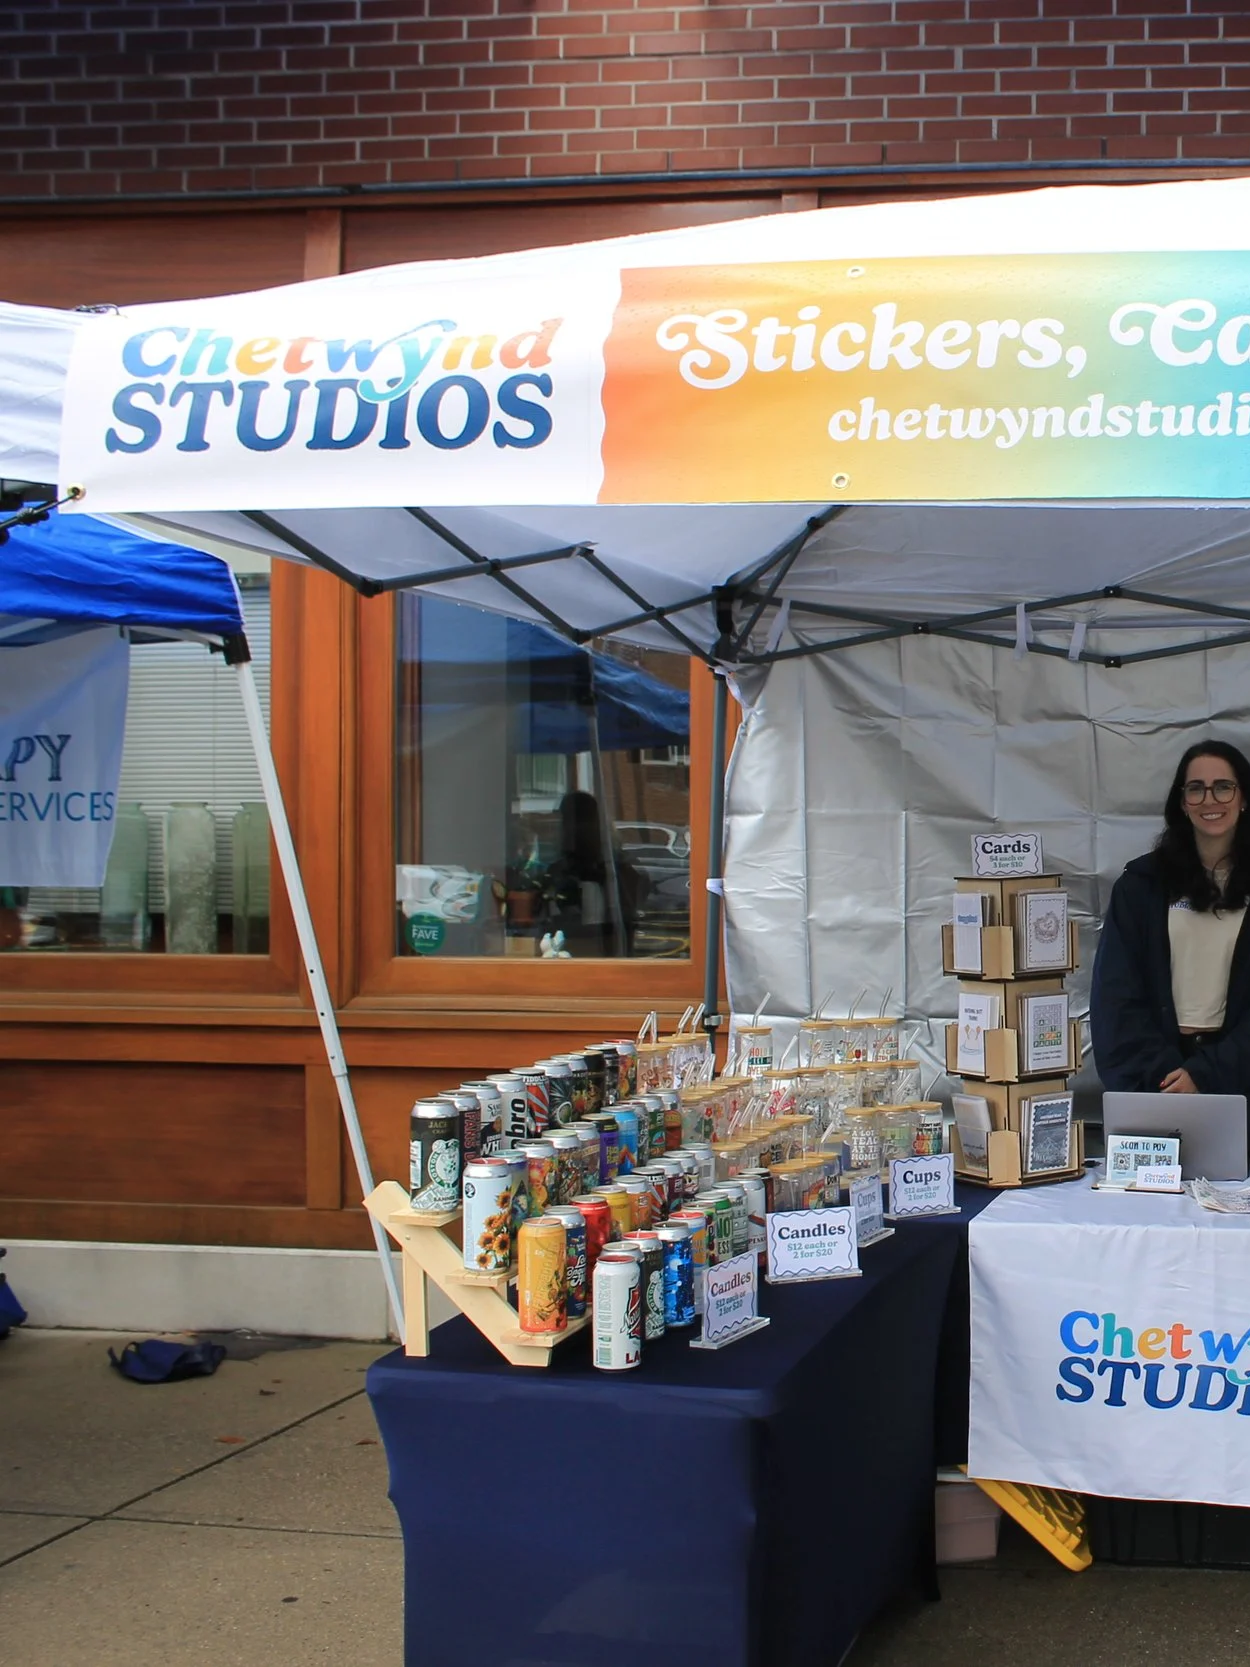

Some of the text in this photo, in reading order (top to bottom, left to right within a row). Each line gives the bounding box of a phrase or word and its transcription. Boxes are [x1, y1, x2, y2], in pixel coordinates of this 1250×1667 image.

[656, 302, 1087, 389] Stickers,
[121, 317, 565, 401] Chetwynd
[105, 372, 555, 453] STUDIOS
[0, 734, 71, 782] PY
[981, 841, 1031, 854] Cards
[412, 928, 439, 940] FAVE
[1120, 1140, 1167, 1152] SCAN TO PAY
[903, 1170, 941, 1185] Cups
[1143, 1177, 1175, 1185] STUDIOS
[857, 1191, 876, 1208] Cups
[778, 1223, 846, 1240] Candles
[787, 1240, 838, 1251] $12 each or
[793, 1248, 833, 1259] 2 for $20
[711, 1271, 751, 1298] Candles
